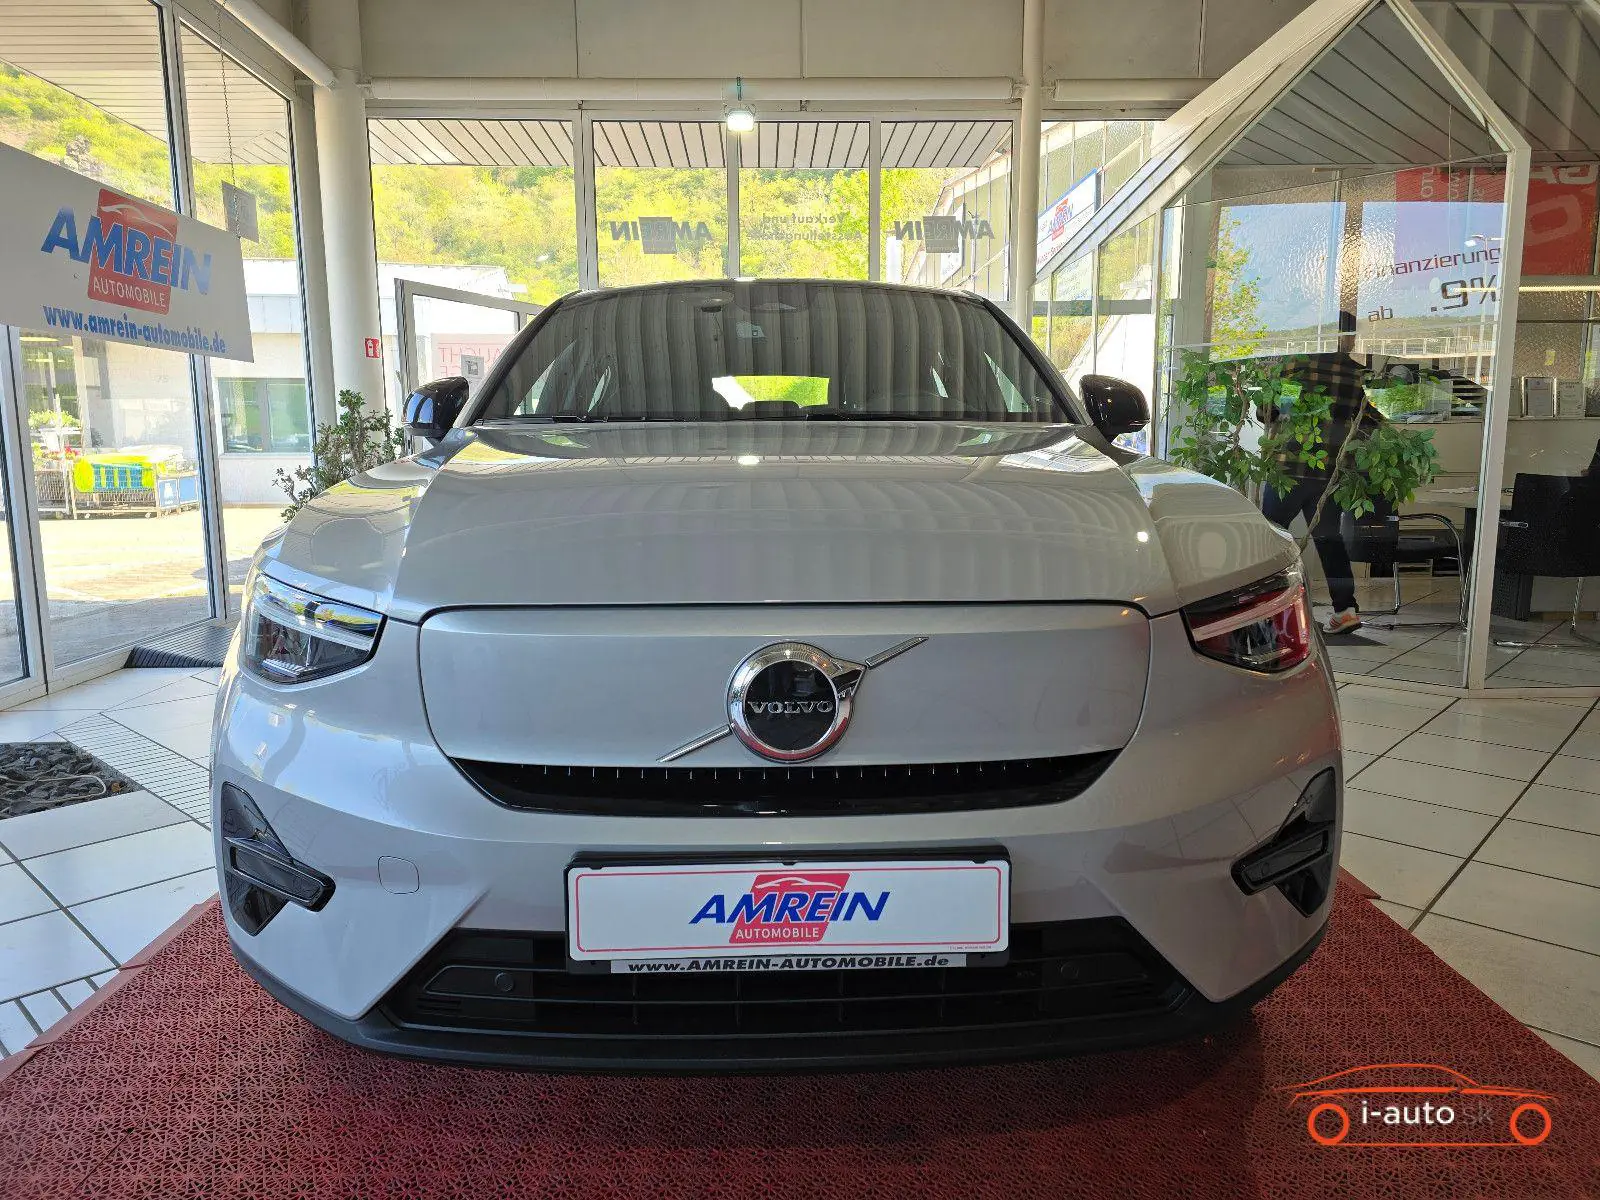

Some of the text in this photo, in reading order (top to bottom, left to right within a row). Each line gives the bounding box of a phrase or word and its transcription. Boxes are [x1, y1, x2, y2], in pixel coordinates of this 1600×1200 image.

[41, 205, 212, 295] AMREIN
[93, 276, 167, 308] AUTOMOBILE
[1367, 305, 1394, 323] ab
[43, 305, 227, 354] www.amrein-automobile.de
[747, 700, 834, 714] VOLVO
[688, 891, 890, 924] AMREIN
[736, 927, 820, 940] AUTOMOBILE
[628, 955, 950, 973] www.AMREIN-AUTOMOBILE.de
